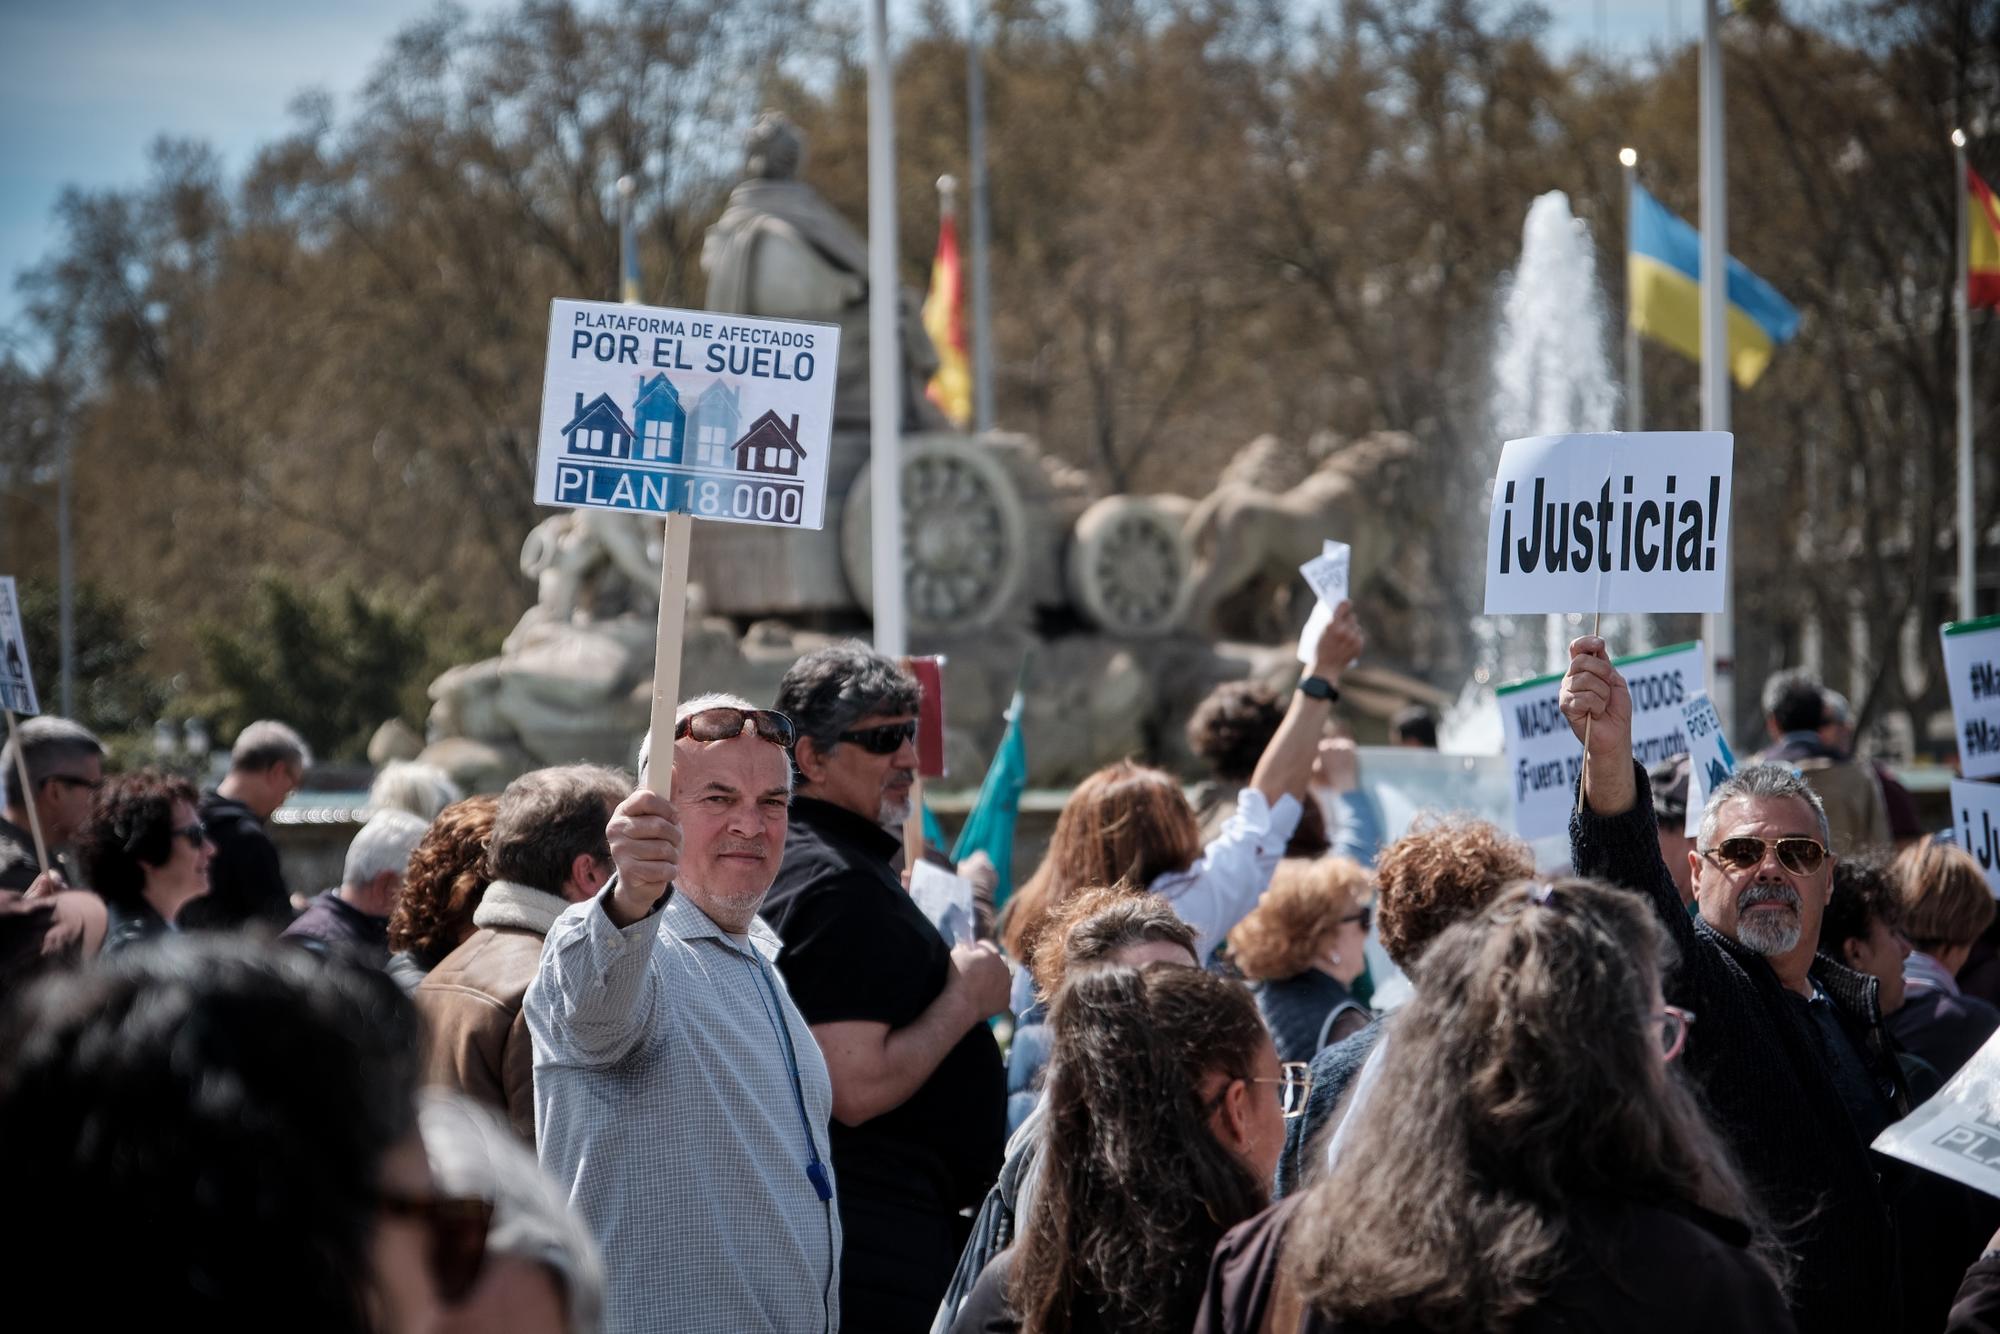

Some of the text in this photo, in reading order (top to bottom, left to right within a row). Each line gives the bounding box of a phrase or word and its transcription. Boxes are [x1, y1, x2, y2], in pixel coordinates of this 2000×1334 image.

[571, 330, 815, 382] POR EL SUELO
[574, 311, 815, 349] PLATAFORMA DE AFECTADOS
[557, 467, 800, 523] PLAN 18.000
[1500, 475, 1721, 574] ¡Justicia!
[1516, 697, 1569, 738] MADR
[1629, 669, 1683, 714] TODOS
[1687, 713, 1713, 742] POR
[1965, 717, 2000, 757] #Ma
